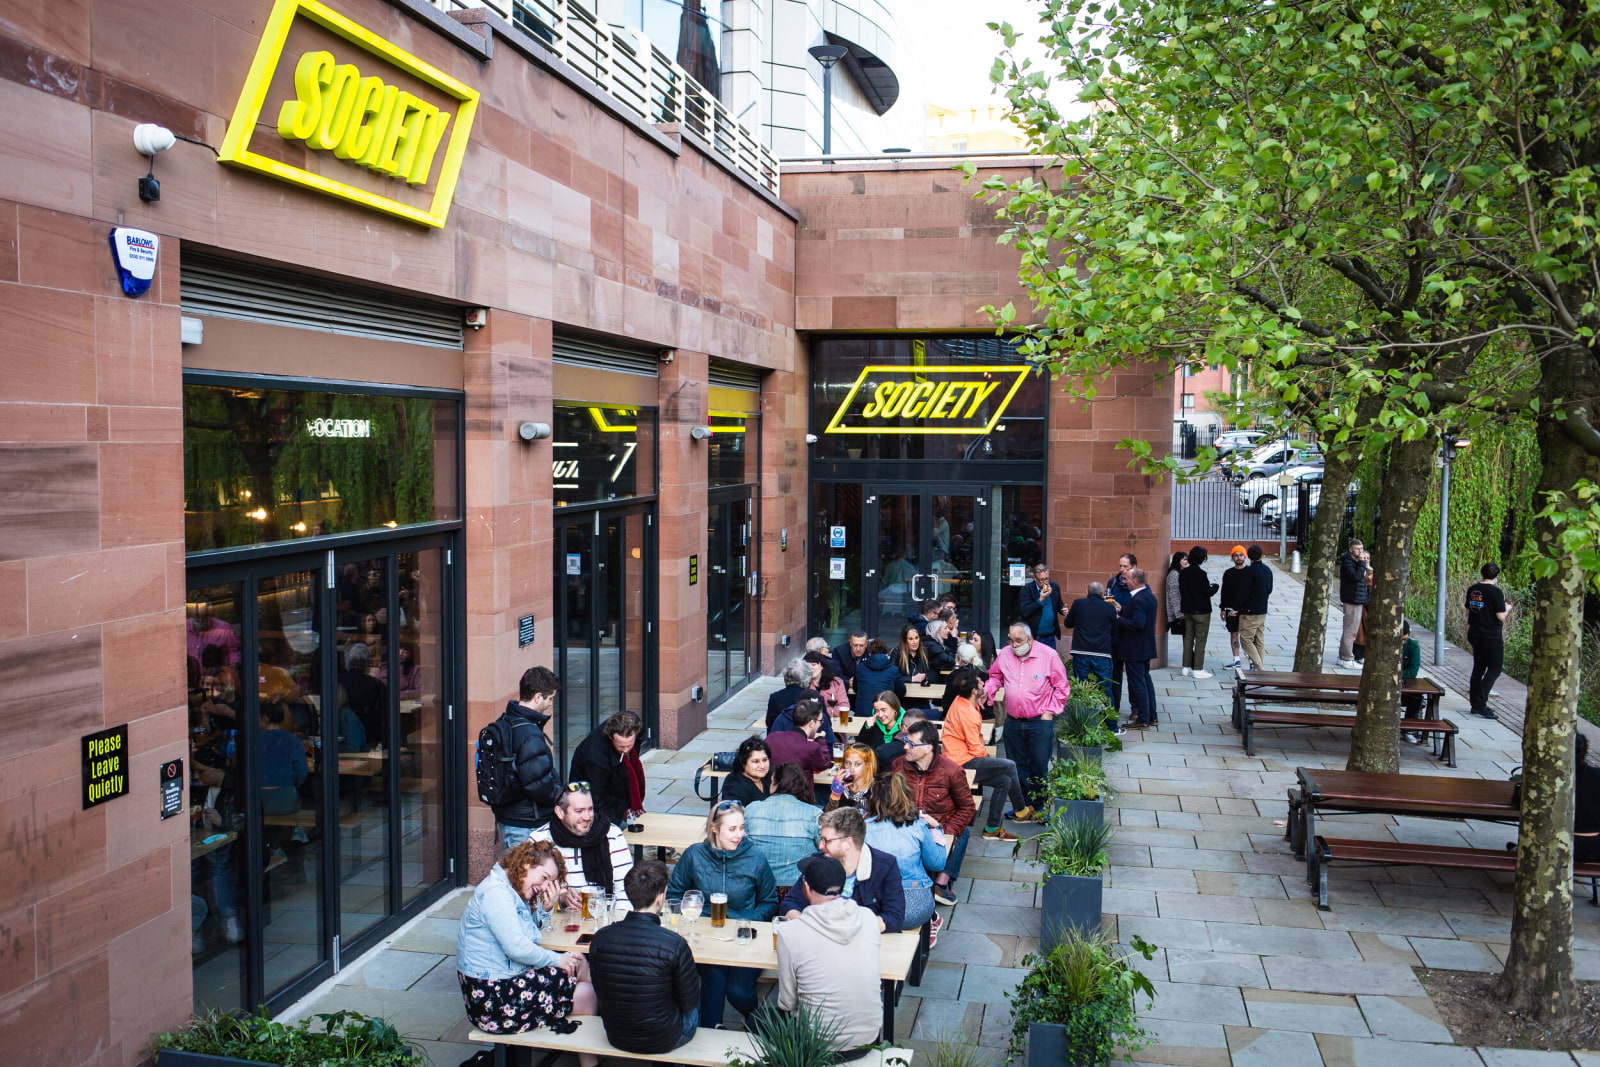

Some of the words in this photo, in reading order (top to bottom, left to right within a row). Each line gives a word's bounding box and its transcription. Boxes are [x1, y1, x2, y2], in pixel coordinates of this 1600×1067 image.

[277, 51, 451, 184] SOCIETY
[127, 235, 153, 247] BARLOWS
[862, 381, 1001, 418] SOCIETY
[88, 734, 121, 758] Please
[91, 756, 119, 779] Leave
[88, 774, 123, 803] Quietly
